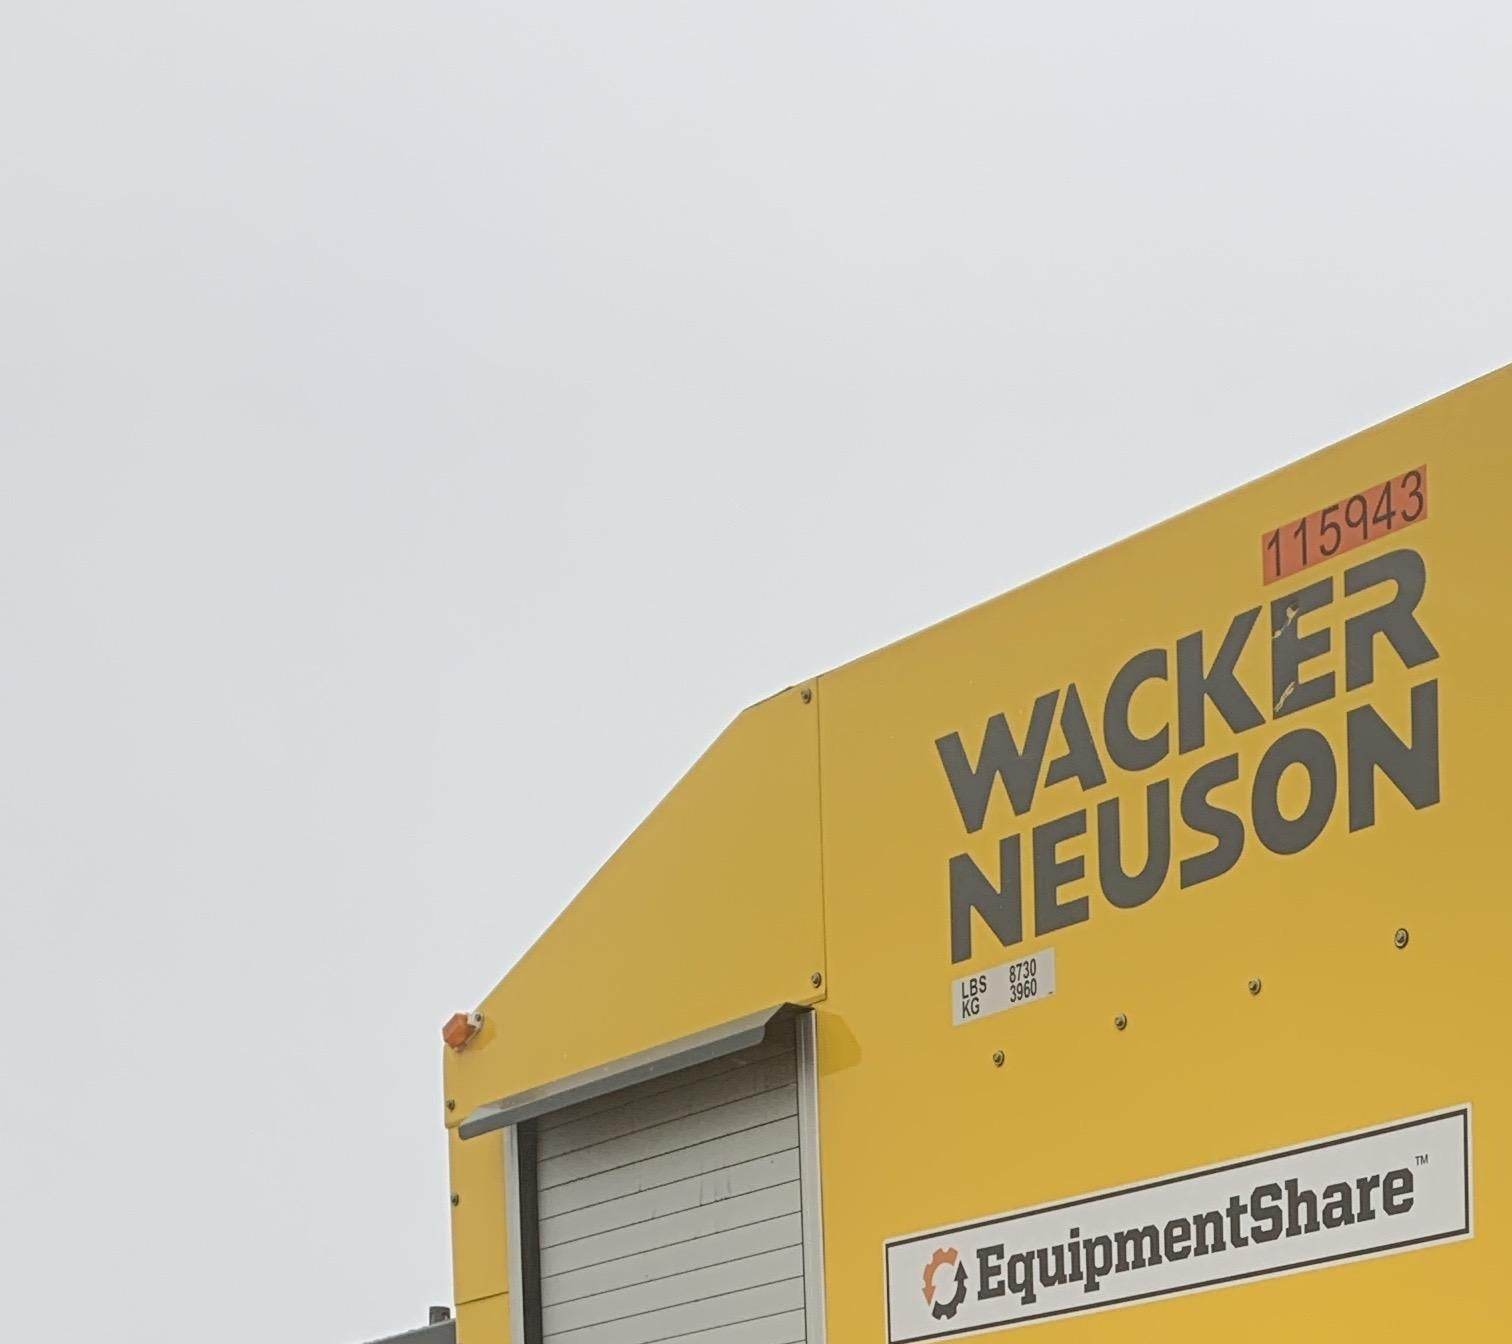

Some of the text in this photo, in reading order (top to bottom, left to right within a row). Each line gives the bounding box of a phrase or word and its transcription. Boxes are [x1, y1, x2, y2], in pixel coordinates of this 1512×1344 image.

[1266, 470, 1424, 577] 115943
[935, 548, 1440, 835] WACKER
[948, 678, 1441, 965] NEUSON
[961, 958, 1037, 1000] LBS 8730
[961, 977, 1038, 1019] KG 3960
[976, 1166, 1415, 1305] EquipmentShare
